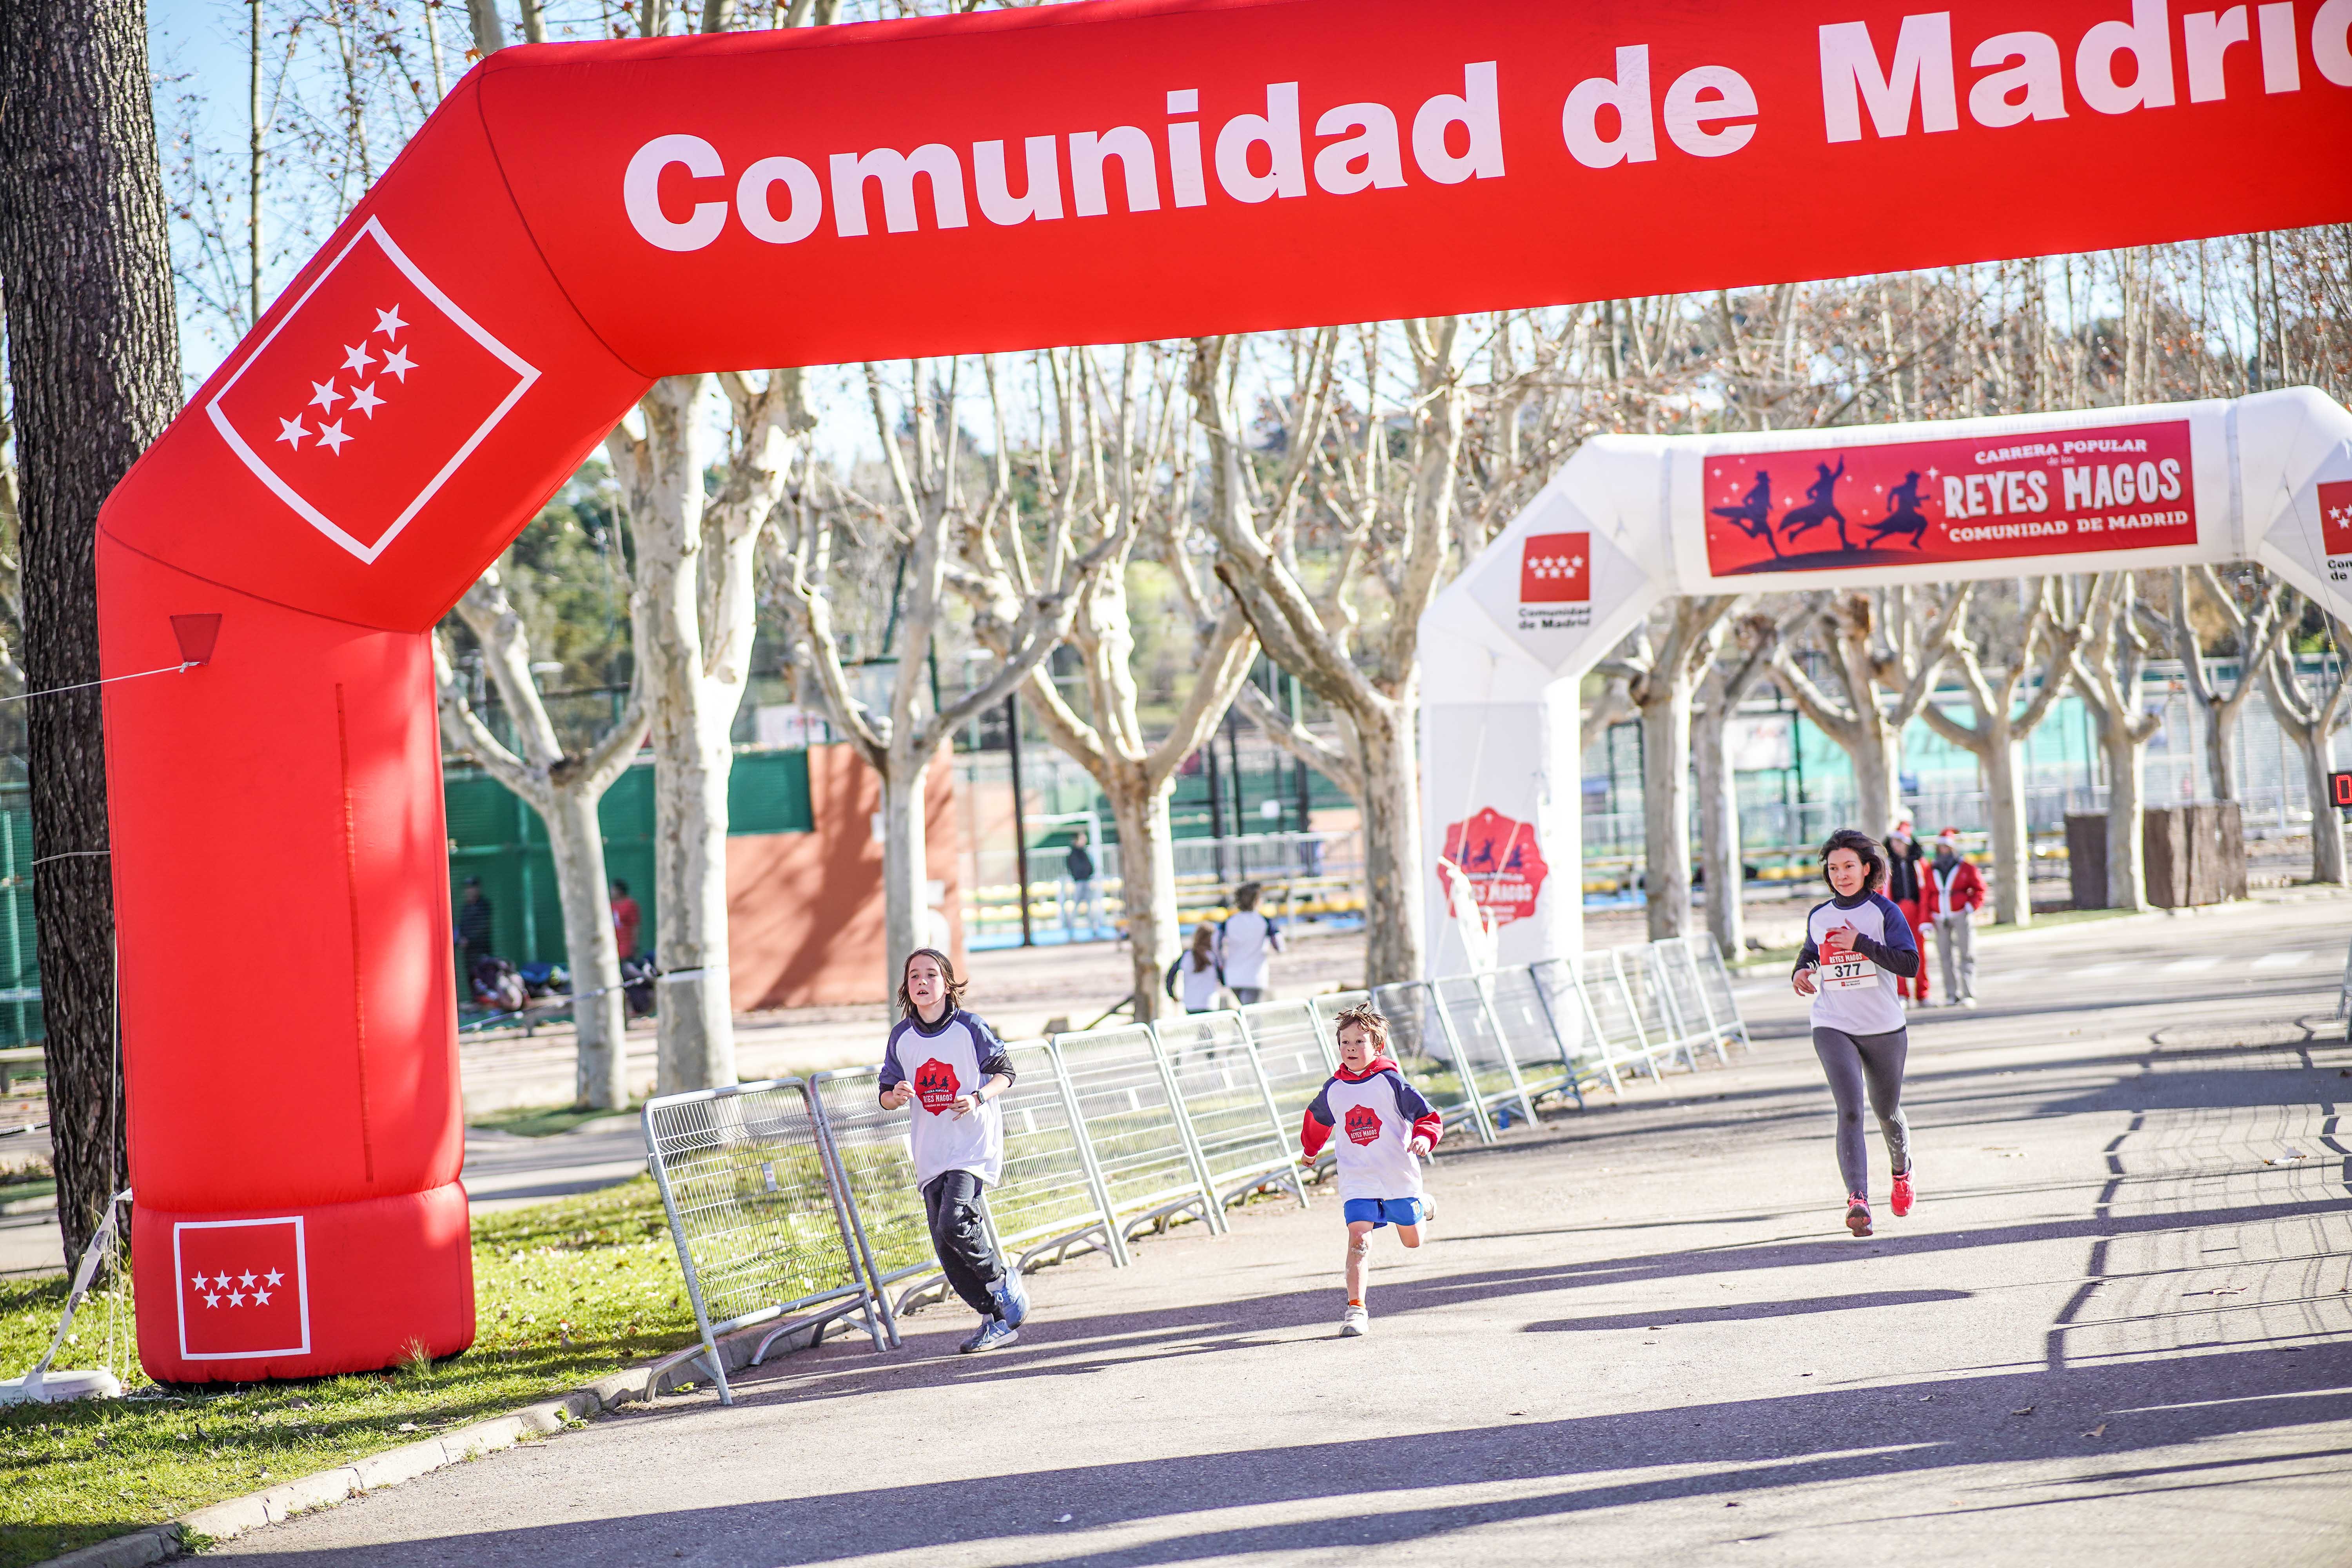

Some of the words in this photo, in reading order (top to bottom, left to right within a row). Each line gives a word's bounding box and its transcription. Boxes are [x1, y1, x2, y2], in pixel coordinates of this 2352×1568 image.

[623, 60, 1505, 252] Comunidad
[1563, 44, 1759, 168] de
[1975, 443, 2059, 465] CARRERA
[2062, 439, 2147, 454] POPULAR
[2046, 455, 2059, 466] de
[2061, 455, 2075, 465] los
[1942, 470, 2049, 519] REYES
[2062, 457, 2181, 512] MAGOS
[1949, 520, 2069, 543] COMUNIDAD
[2076, 517, 2103, 533] DE
[2107, 510, 2189, 531] MADRID
[2330, 570, 2347, 580] de
[1518, 607, 1591, 617] Comunidad
[1518, 620, 1535, 629] de
[1541, 618, 1590, 628] Madrid
[1829, 955, 1844, 964] REYES
[1845, 953, 1862, 962] MAGOS
[1835, 963, 1860, 977] 377
[936, 1093, 953, 1102] MAGOS
